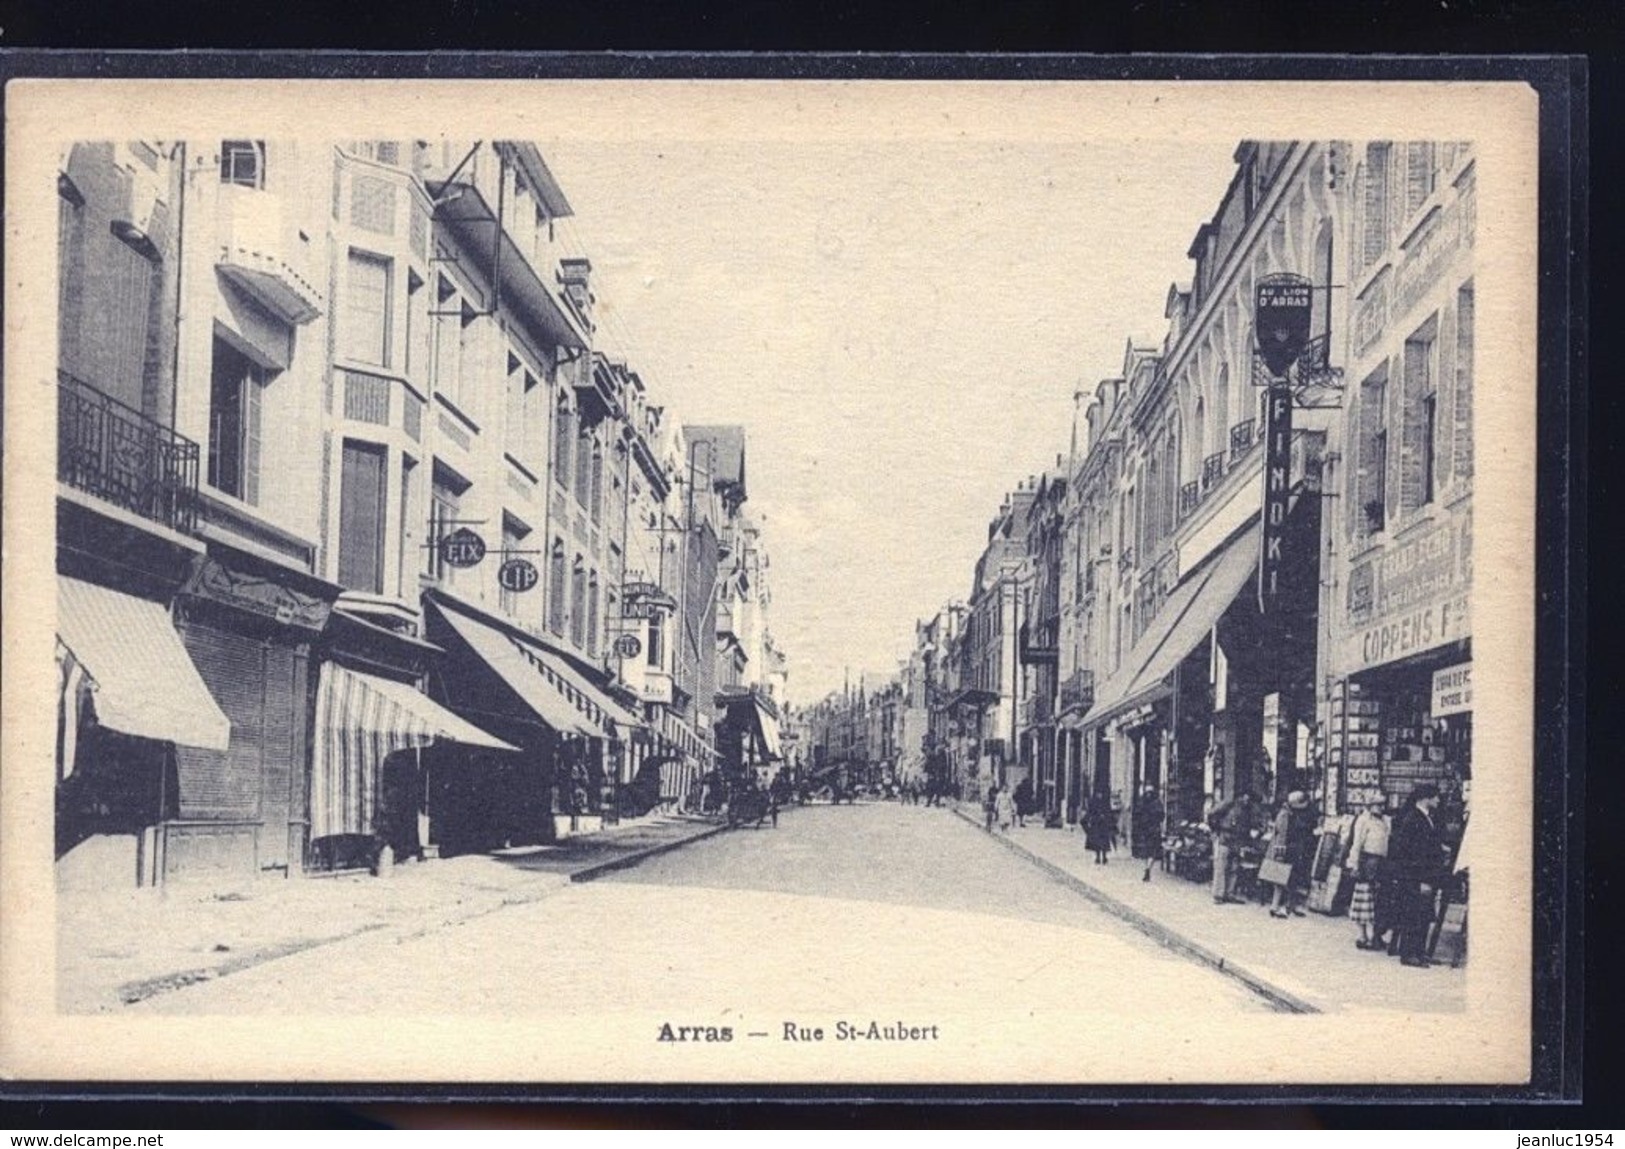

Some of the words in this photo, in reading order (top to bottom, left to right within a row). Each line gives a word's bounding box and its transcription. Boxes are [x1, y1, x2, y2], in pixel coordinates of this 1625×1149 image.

[1260, 288, 1275, 296] AU
[1283, 288, 1309, 296] LION
[1260, 297, 1309, 307] D'ARRAS
[1267, 399, 1286, 595] FINOKI
[447, 544, 481, 561] FIX
[501, 566, 538, 590] LIP
[1363, 609, 1434, 663] COPPENS
